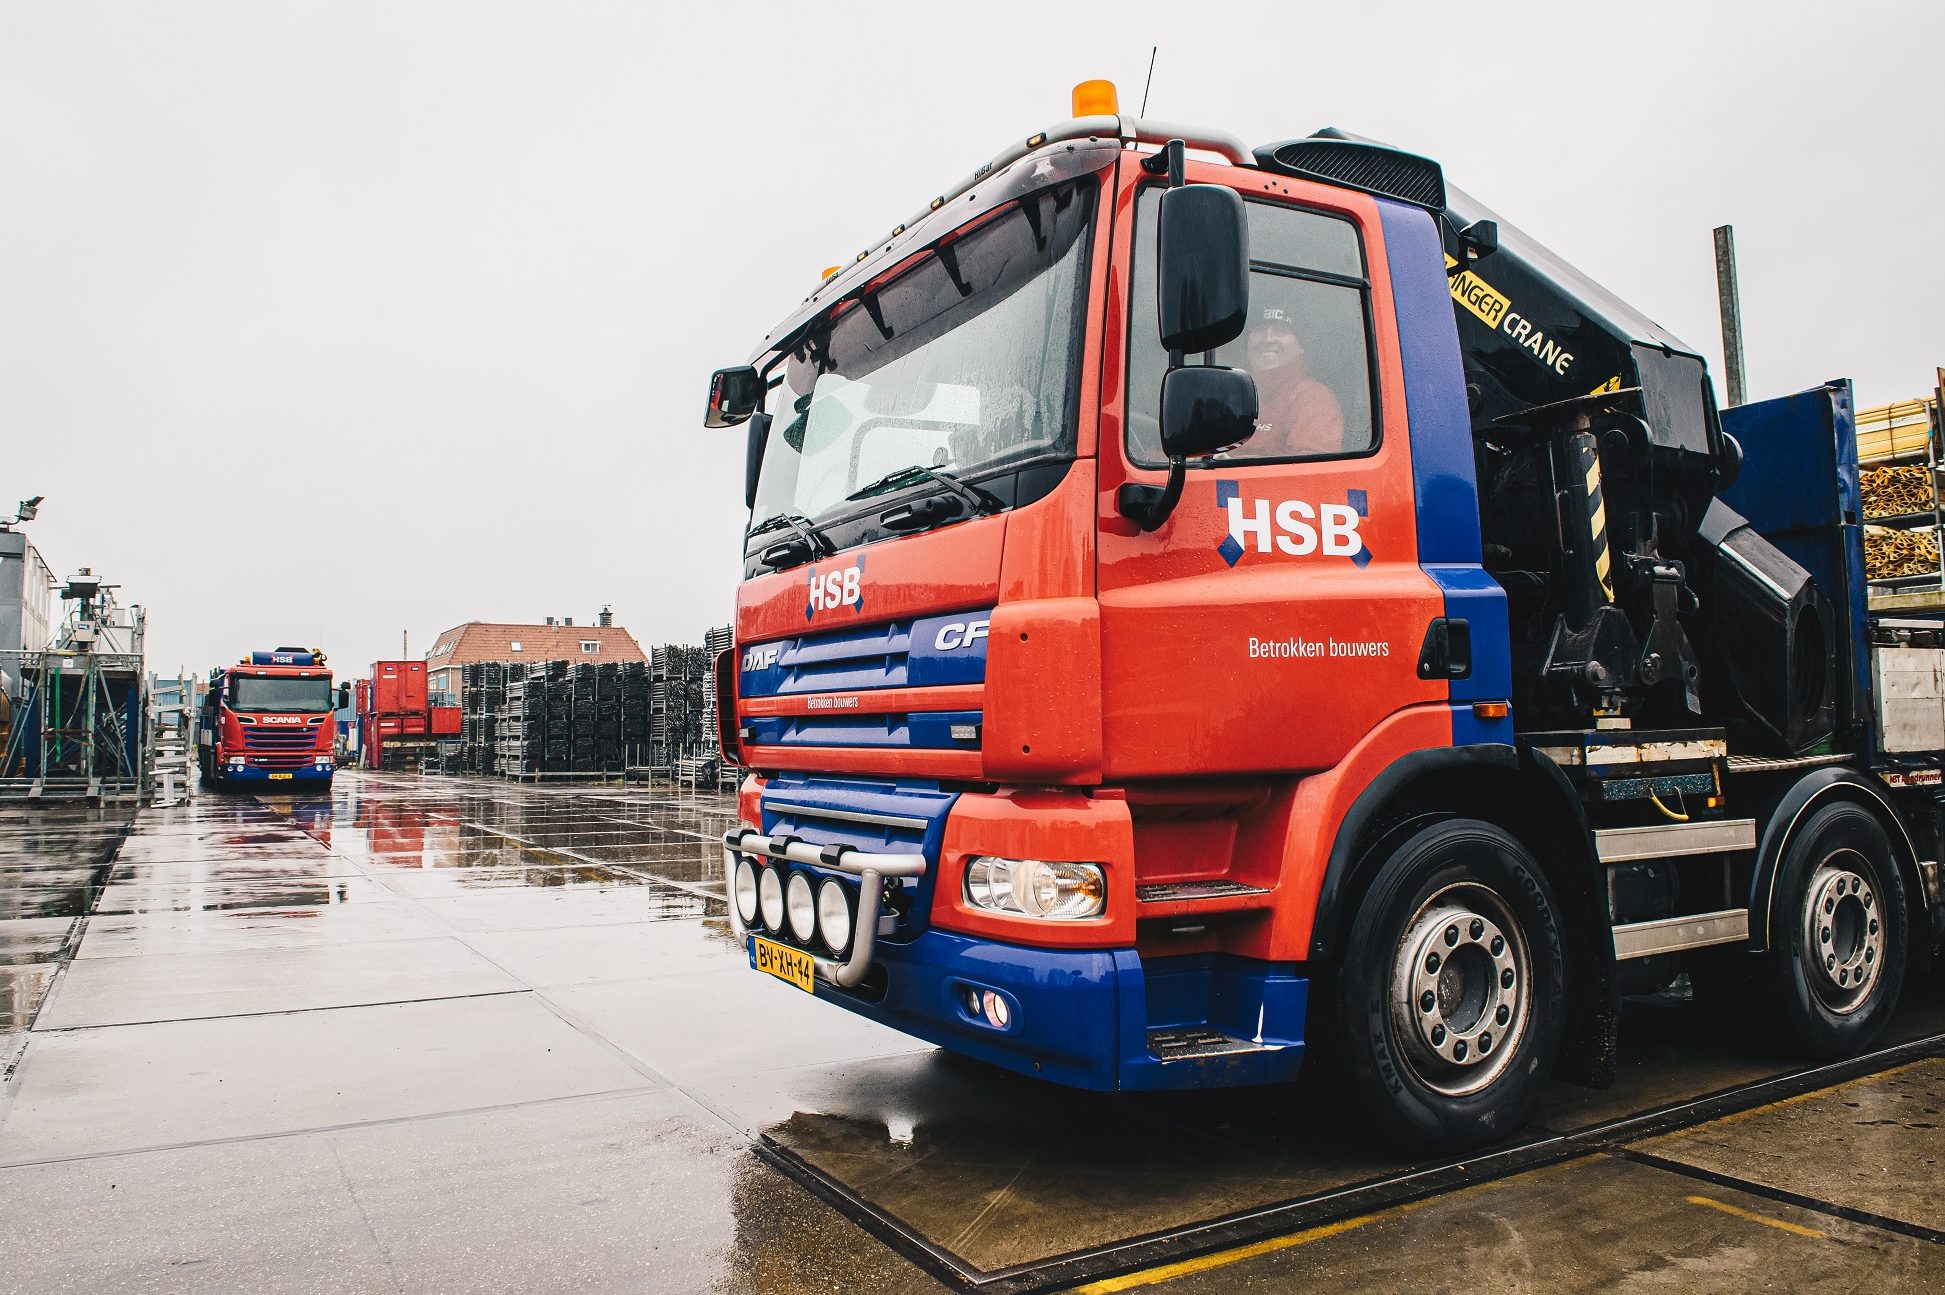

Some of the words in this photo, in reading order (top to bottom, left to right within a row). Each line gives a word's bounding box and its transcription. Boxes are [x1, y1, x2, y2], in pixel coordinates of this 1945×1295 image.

[1450, 273, 1504, 322] INGER
[1503, 312, 1575, 376] CRANE
[1227, 497, 1363, 557] HSB
[809, 566, 861, 611] HSB
[934, 619, 990, 651] CF
[1249, 637, 1325, 658] Betrokken
[1329, 637, 1389, 657] bouwers
[741, 649, 779, 673] DAF
[807, 696, 833, 709] Betrokken
[833, 694, 859, 708] bouwers
[262, 716, 302, 724] SCANIA
[758, 943, 810, 986] BV-XH-44
